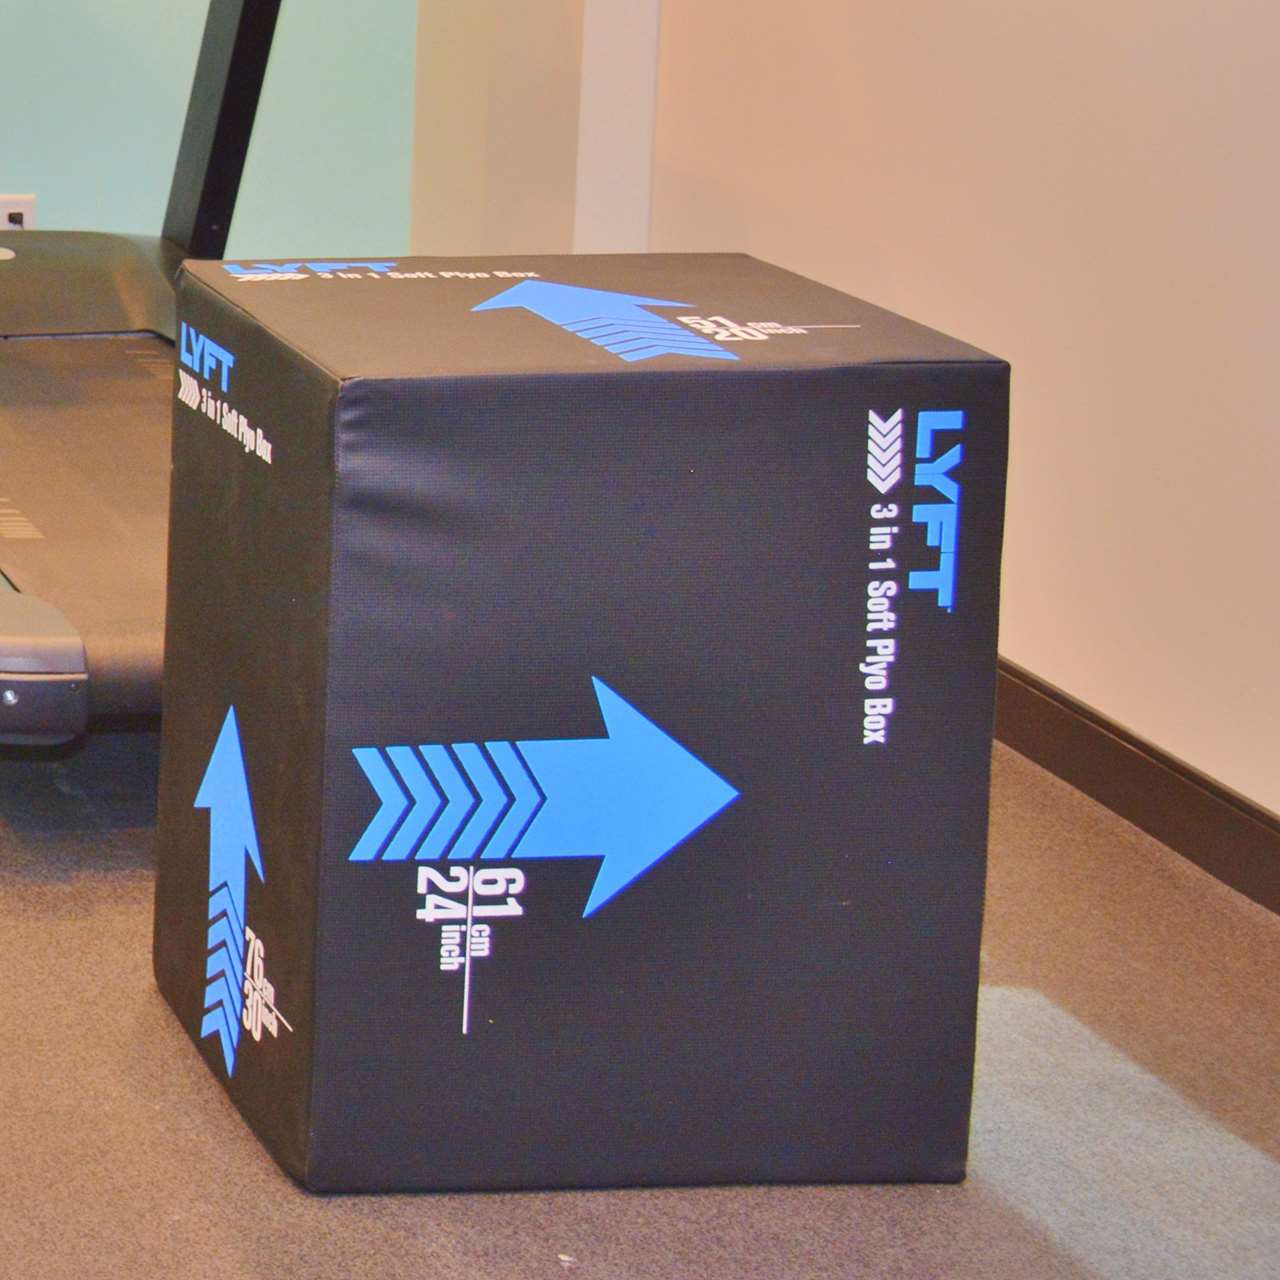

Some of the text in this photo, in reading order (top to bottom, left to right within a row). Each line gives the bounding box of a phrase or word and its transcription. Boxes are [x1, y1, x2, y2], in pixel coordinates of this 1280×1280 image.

[223, 262, 399, 274] LYFT
[316, 271, 334, 279] 3
[337, 271, 362, 279] in
[386, 271, 438, 279] Soft
[439, 271, 491, 280] Plyo
[492, 271, 540, 279] Box
[180, 320, 236, 393] LYFT
[701, 327, 768, 341] 20
[201, 387, 208, 414] 3
[207, 390, 216, 420] in
[256, 427, 272, 465] Box
[908, 409, 965, 610] LYFT
[858, 503, 900, 745] 3 in 1 Soft Plyo Box
[416, 866, 469, 971] 24 inch
[470, 867, 526, 958] 61 cm
